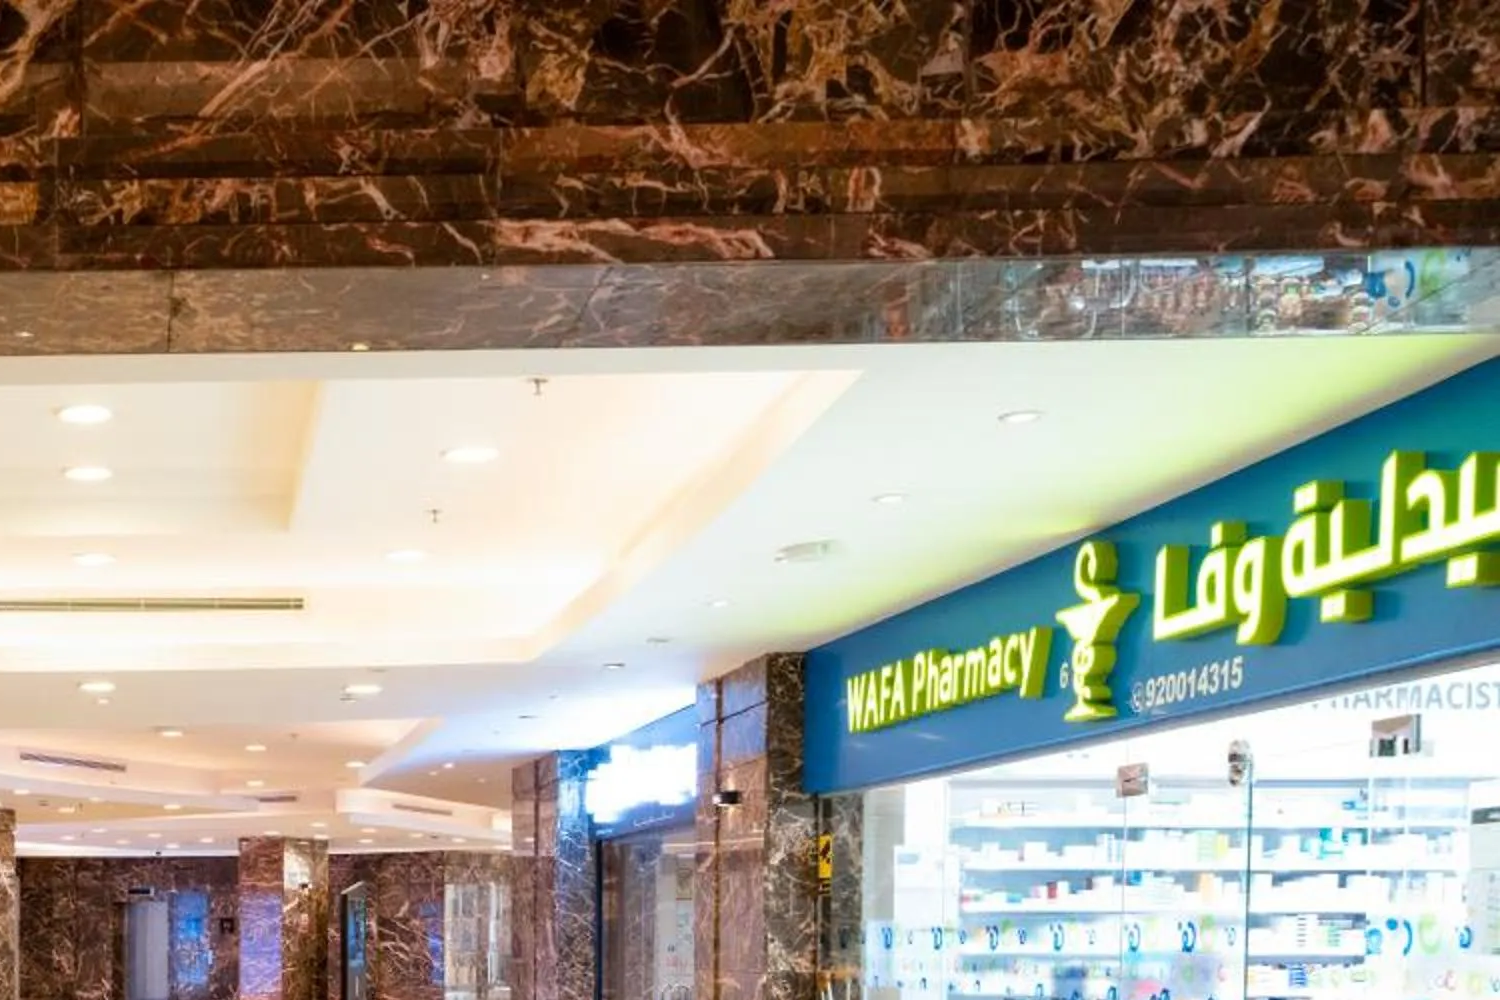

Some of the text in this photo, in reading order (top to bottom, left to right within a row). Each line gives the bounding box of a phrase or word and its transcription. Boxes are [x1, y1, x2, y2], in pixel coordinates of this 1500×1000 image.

[1153, 449, 1500, 645] يدلية وفا
[847, 626, 1042, 734] WAFA Pharmacy
[1145, 655, 1243, 707] 920014315
